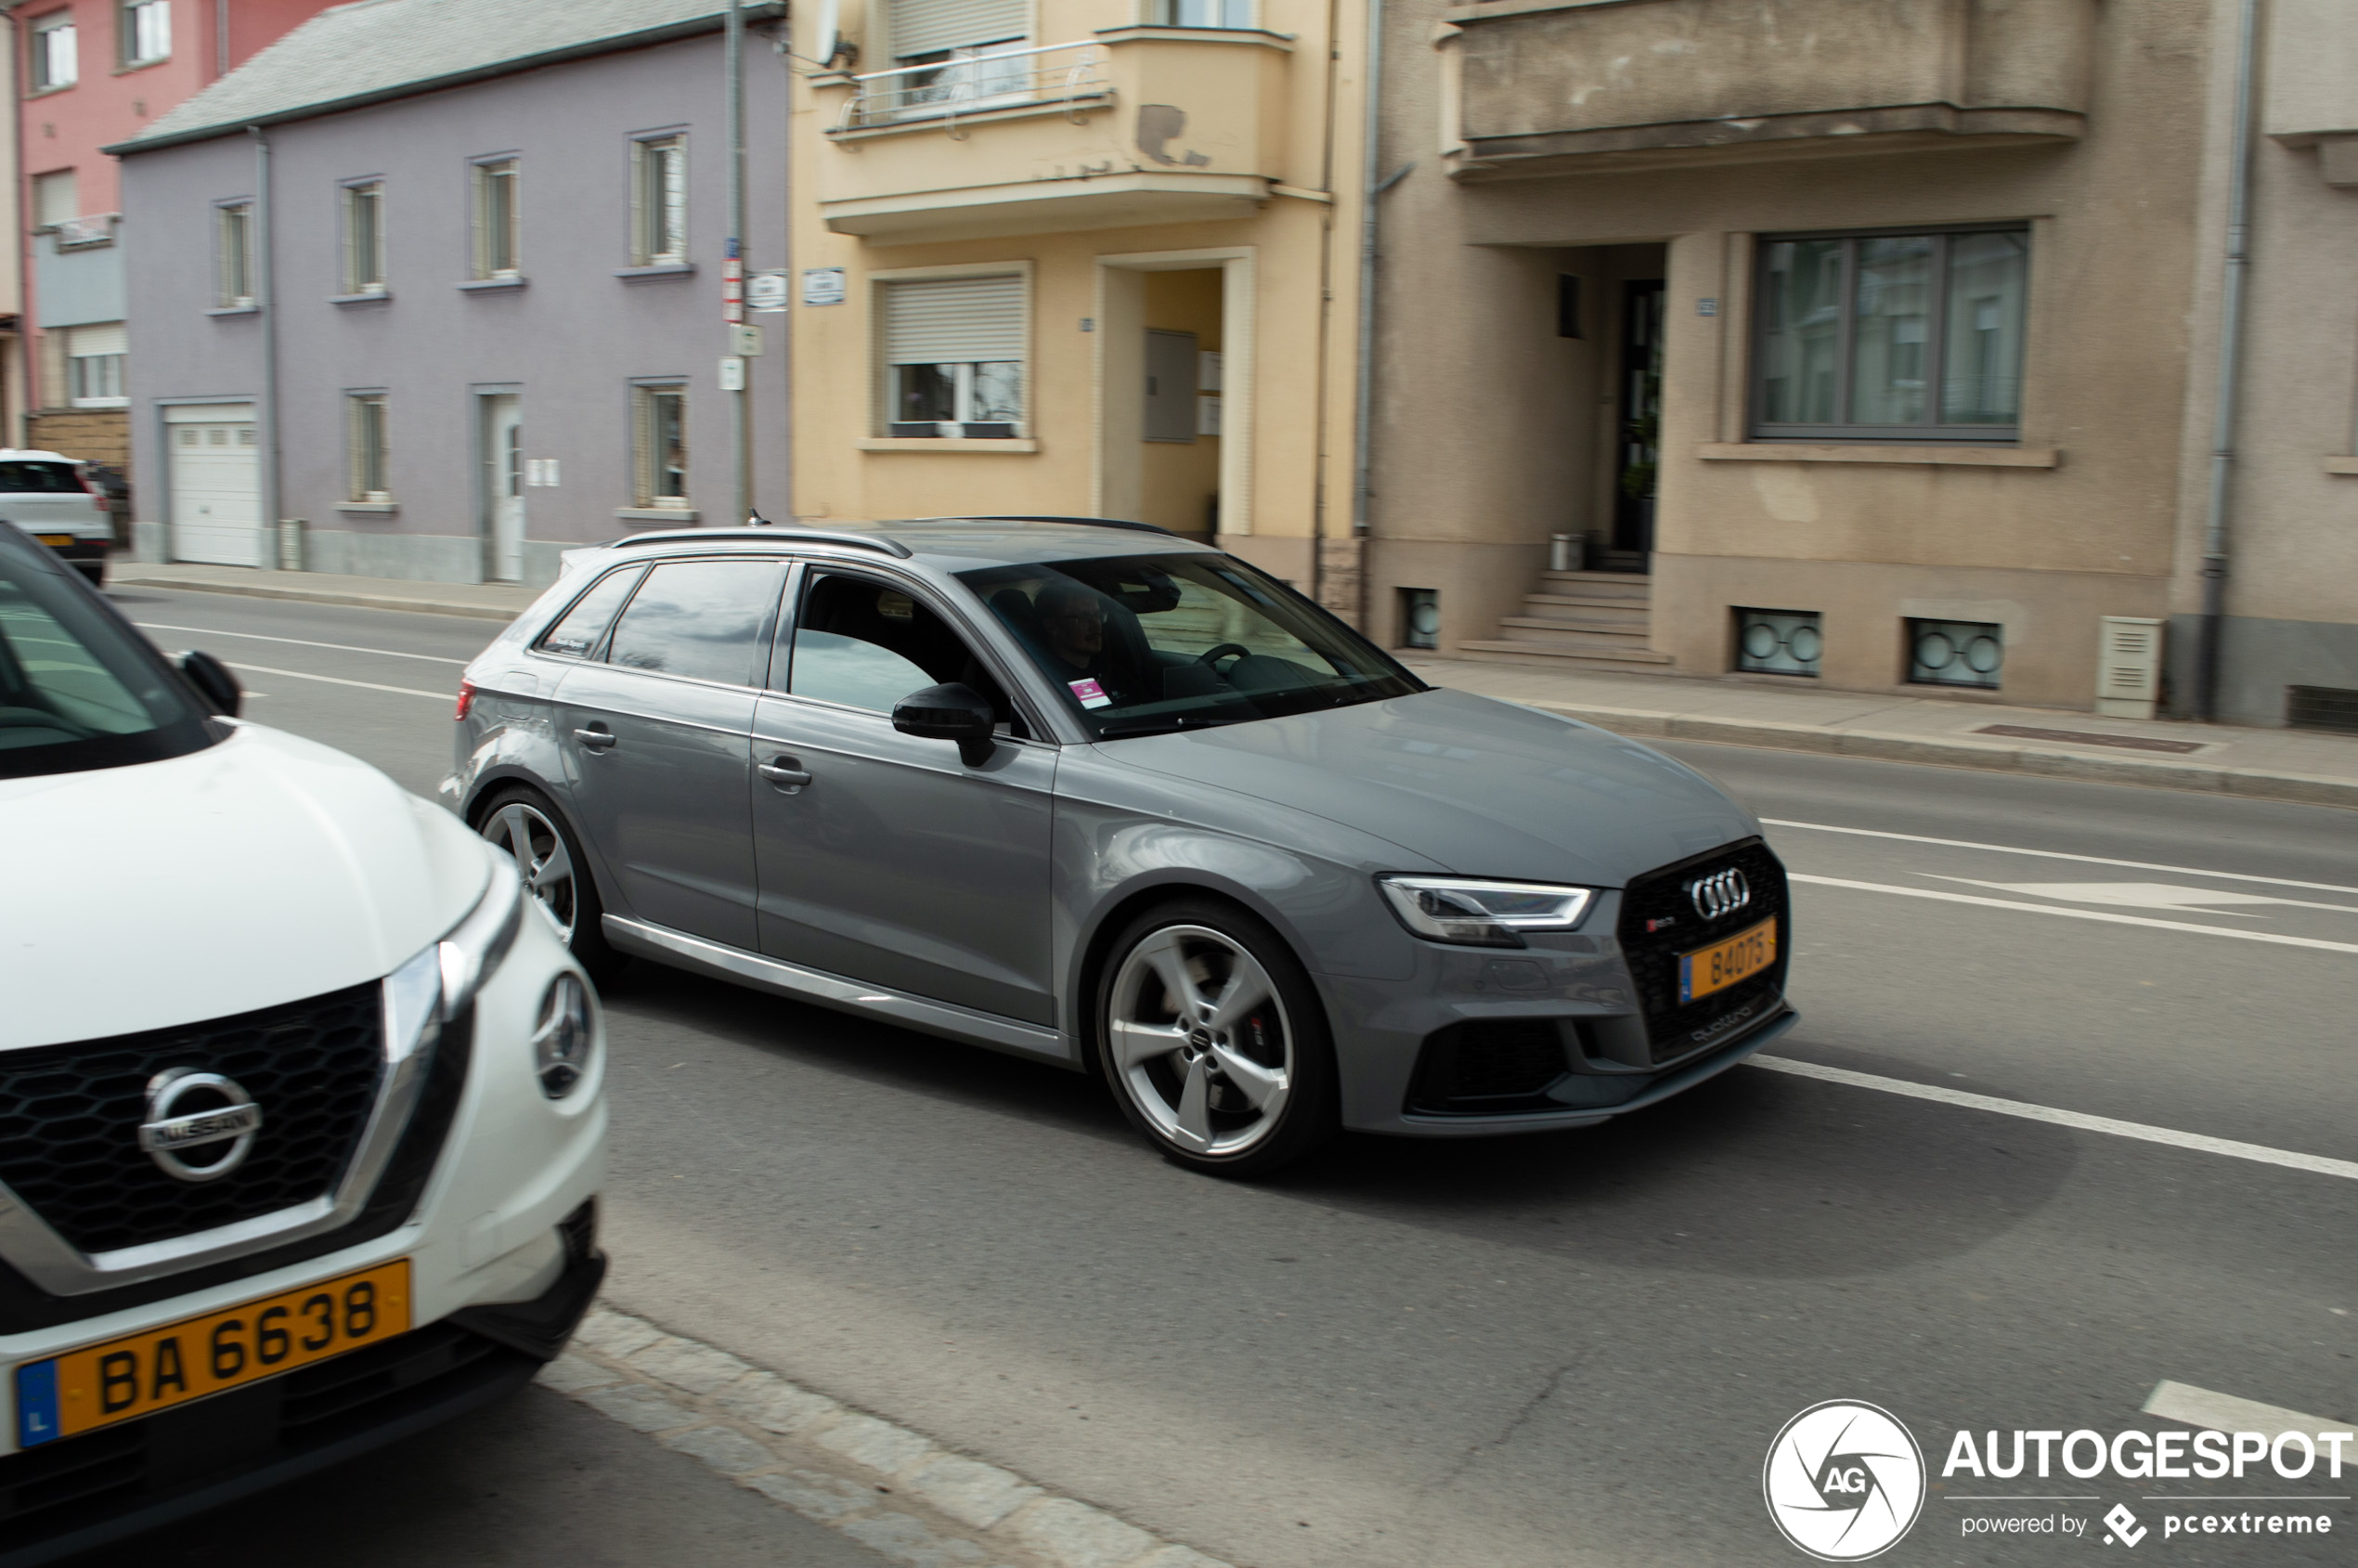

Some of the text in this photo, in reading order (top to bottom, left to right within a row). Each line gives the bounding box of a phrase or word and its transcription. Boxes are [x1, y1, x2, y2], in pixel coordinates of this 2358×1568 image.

[1712, 931, 1764, 985] 84075
[152, 1113, 249, 1144] NISSAN
[100, 1281, 376, 1415] BA 6638
[28, 1412, 49, 1432] L
